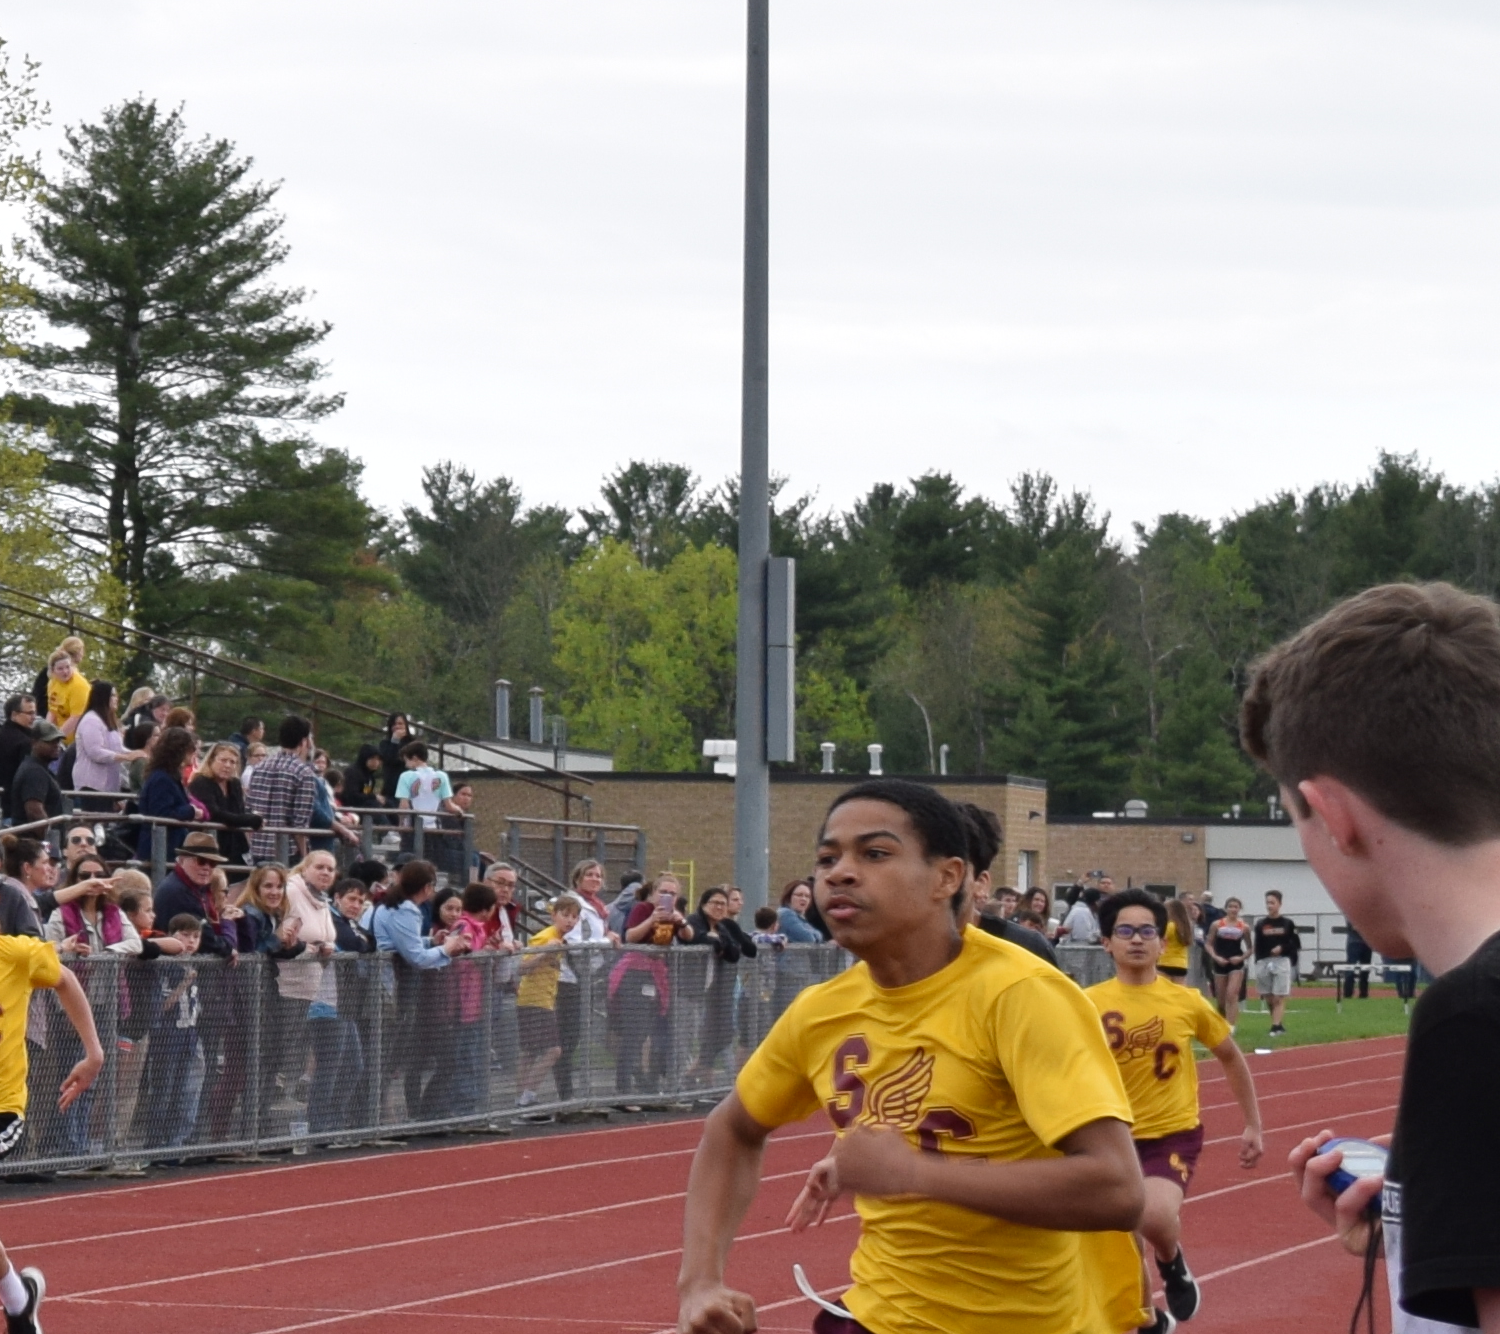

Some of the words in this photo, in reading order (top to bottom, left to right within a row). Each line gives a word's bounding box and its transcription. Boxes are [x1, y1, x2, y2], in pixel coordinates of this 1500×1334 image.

[1101, 1010, 1125, 1050] S
[826, 1032, 871, 1129] S
[1154, 1043, 1179, 1080] C
